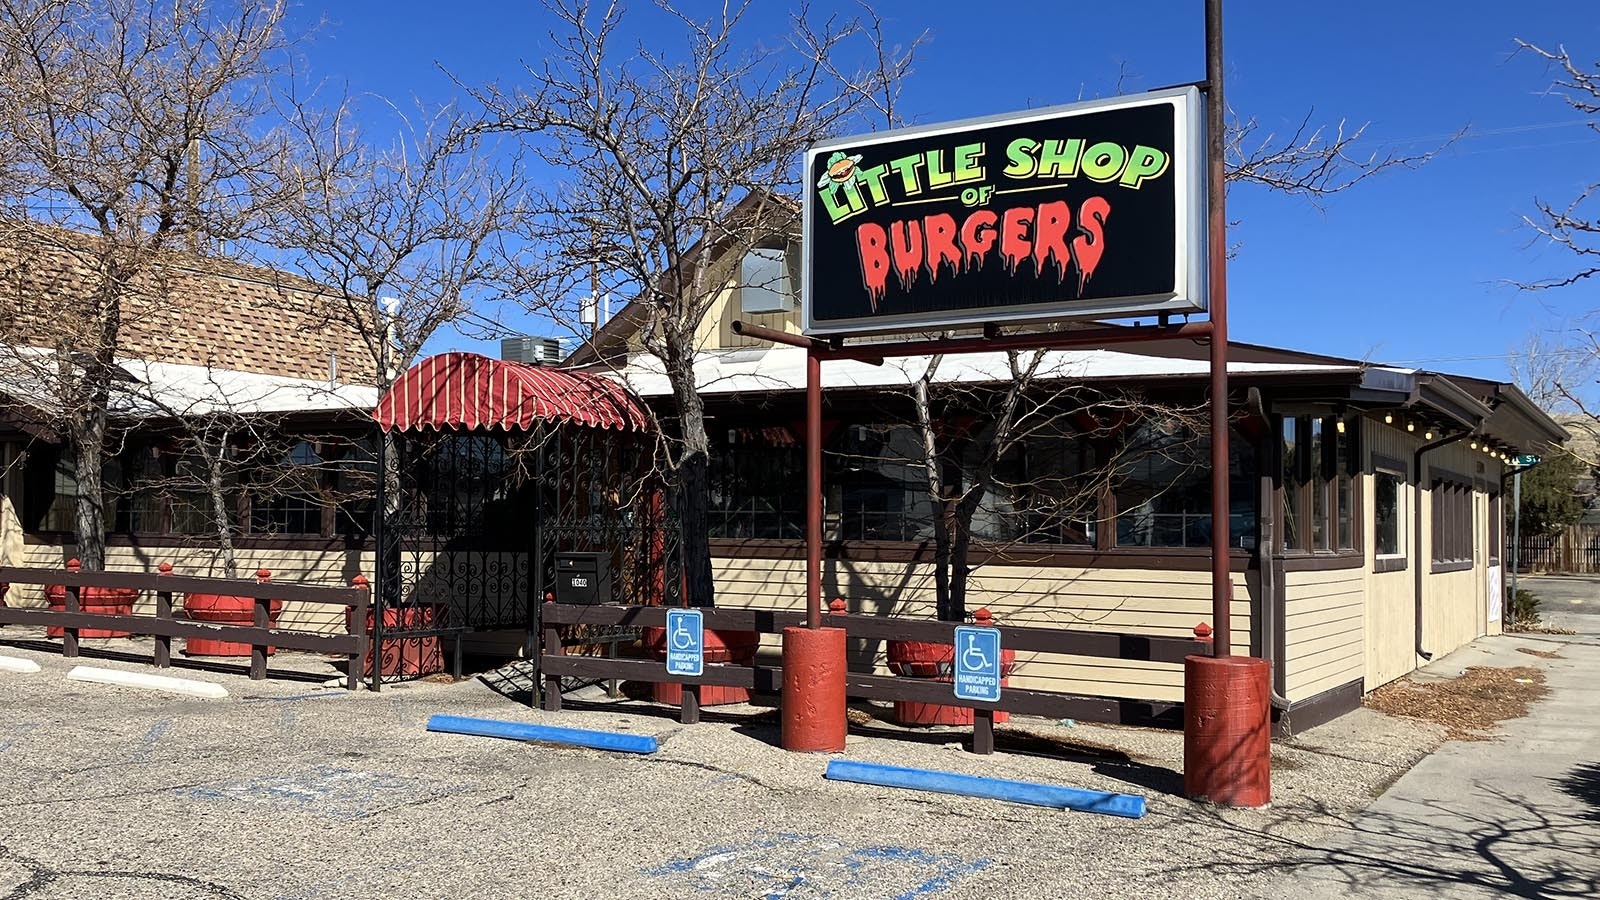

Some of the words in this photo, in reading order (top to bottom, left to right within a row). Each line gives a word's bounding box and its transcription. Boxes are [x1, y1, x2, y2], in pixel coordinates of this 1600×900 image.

[818, 142, 986, 225] LITTLE
[1003, 137, 1170, 190] SHOP
[960, 185, 996, 207] OF
[856, 195, 1112, 313] BURGERS
[572, 578, 587, 587] 1040
[670, 652, 699, 662] HANDICAPPED
[675, 661, 694, 670] PARKING
[958, 674, 996, 686] HANDICAPPED
[964, 685, 989, 695] PARKING
